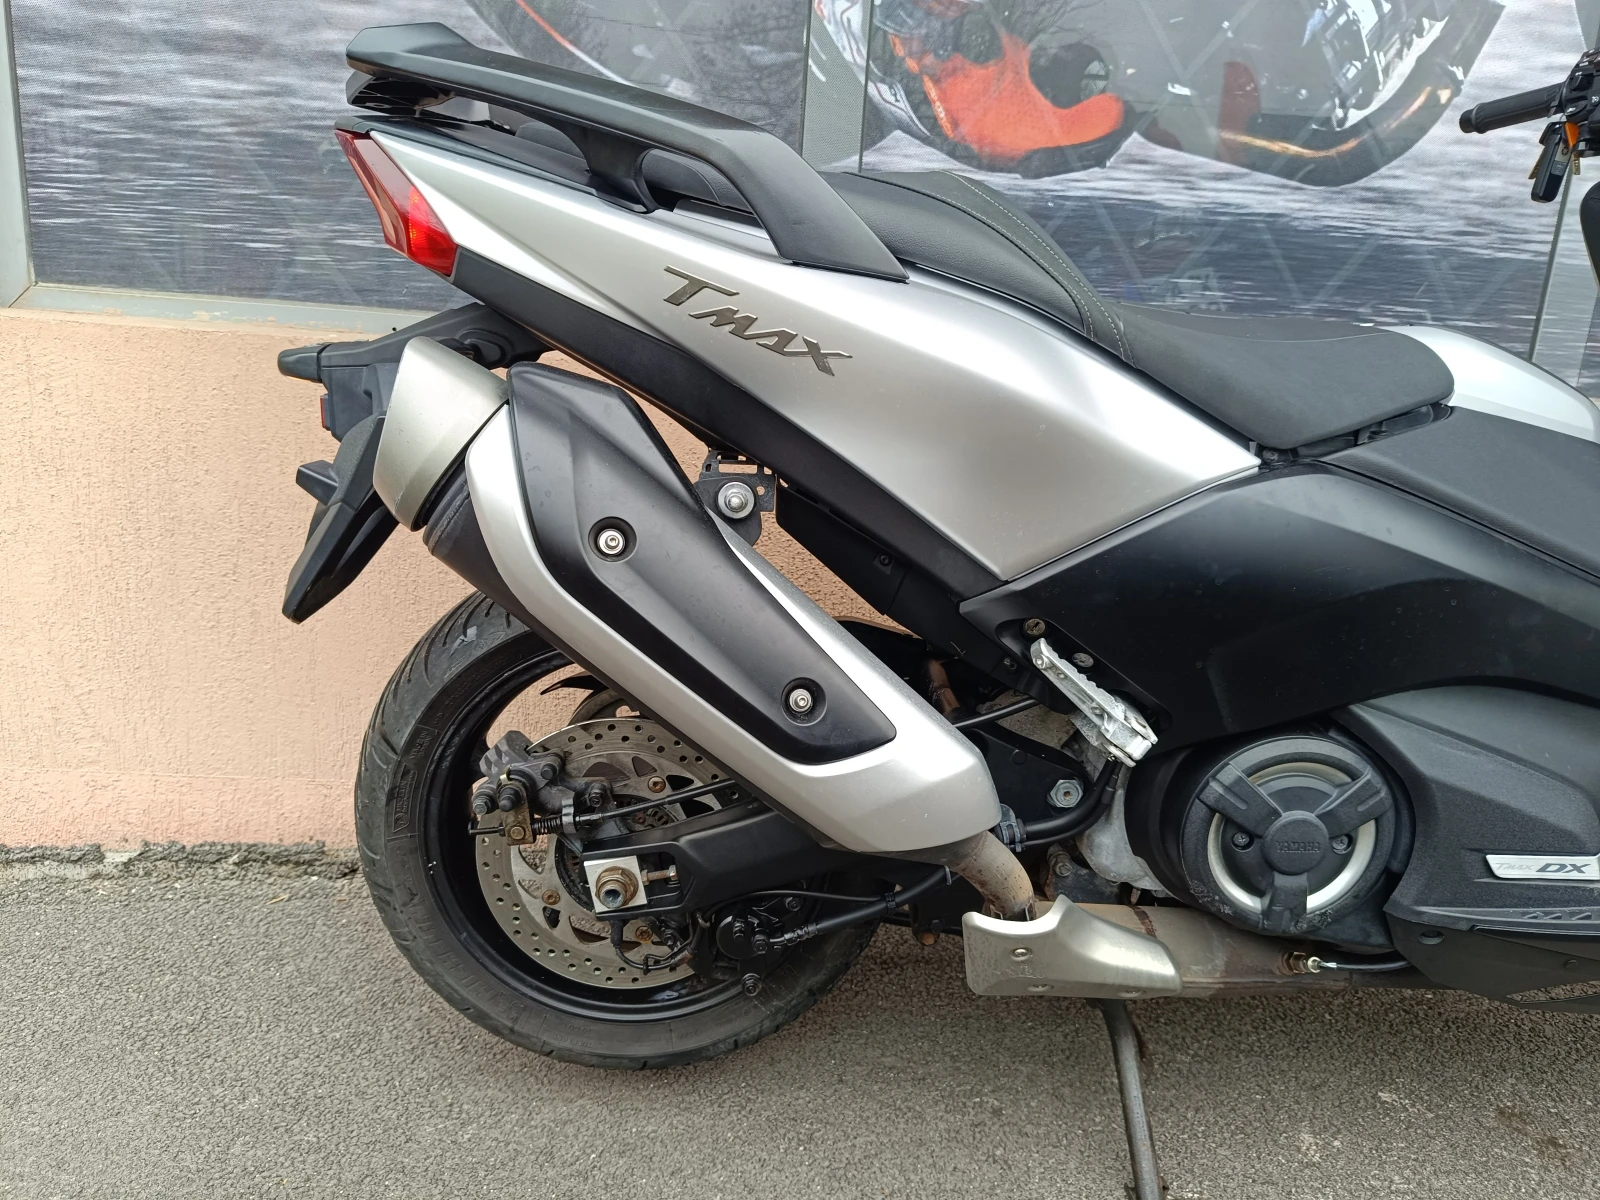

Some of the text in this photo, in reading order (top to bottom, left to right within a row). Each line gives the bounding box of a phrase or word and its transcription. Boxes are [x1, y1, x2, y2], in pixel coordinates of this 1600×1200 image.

[663, 264, 853, 377] TMAX
[1276, 841, 1320, 853] YAMAHA
[1536, 863, 1591, 874] DX
